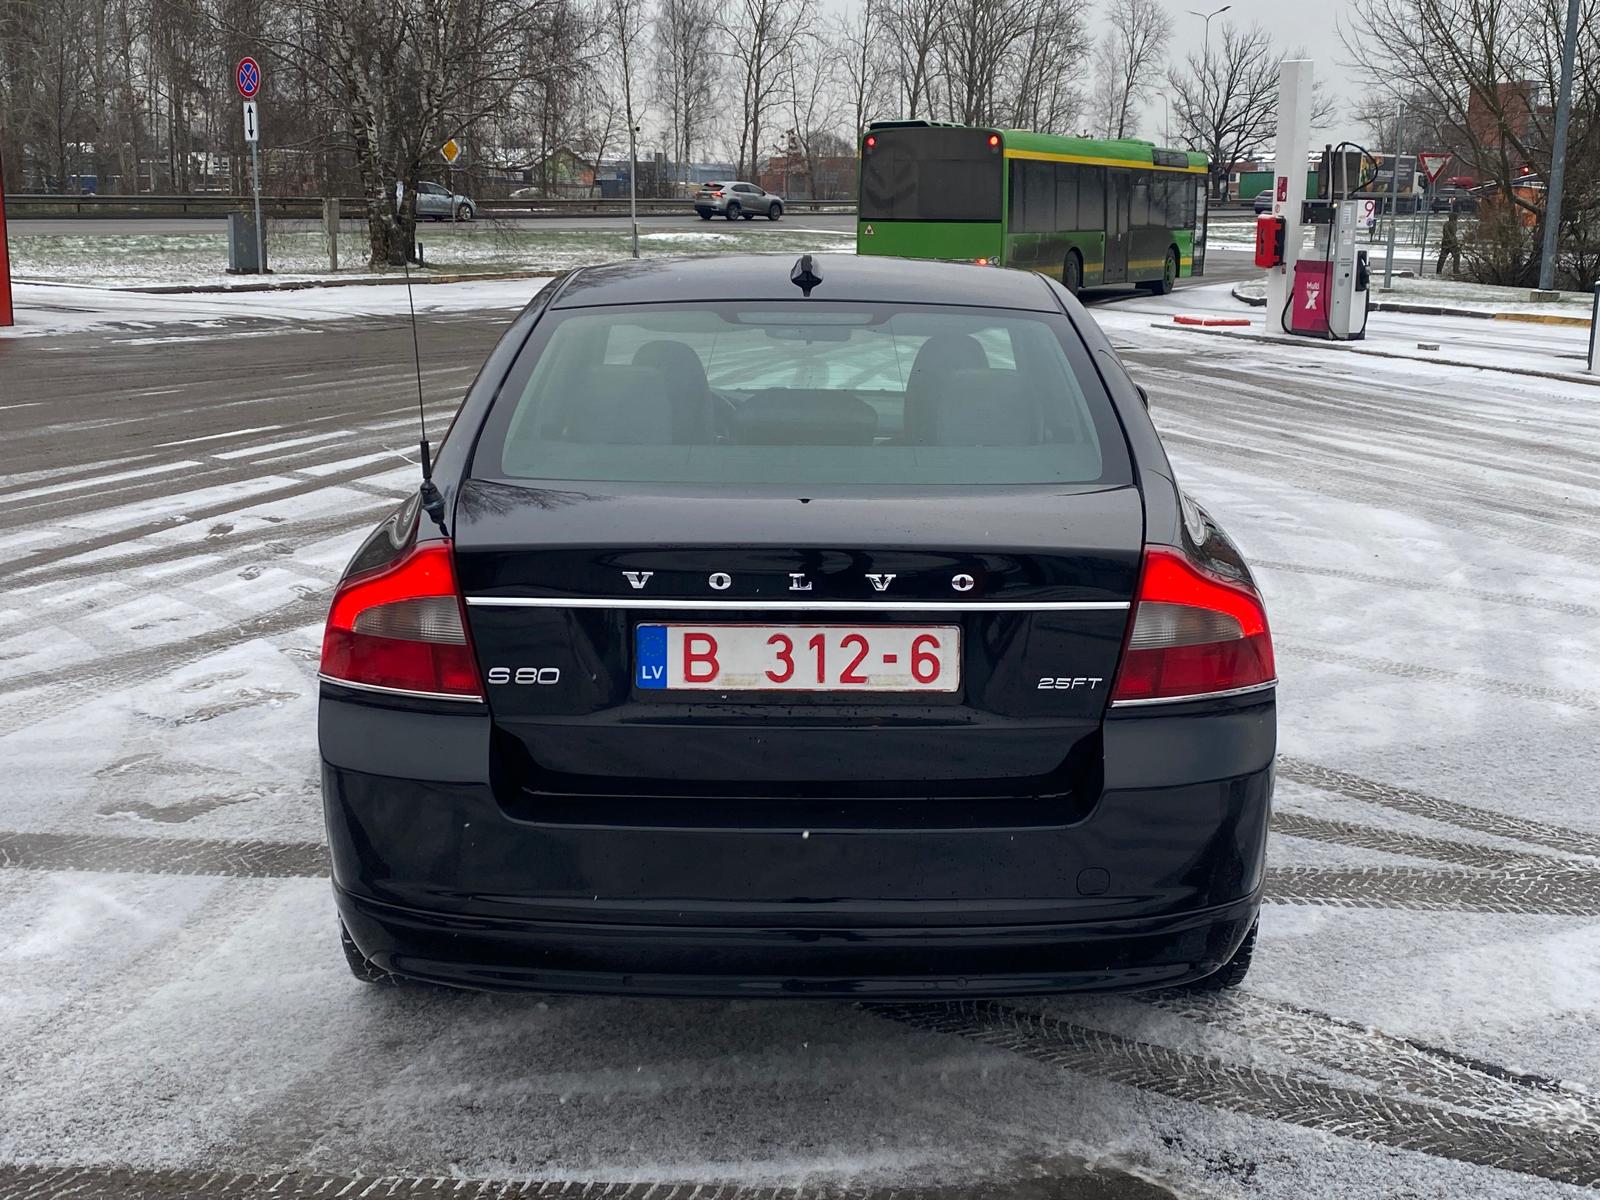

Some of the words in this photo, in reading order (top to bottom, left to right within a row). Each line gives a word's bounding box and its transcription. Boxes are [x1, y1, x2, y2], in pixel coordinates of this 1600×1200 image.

[1364, 200, 1375, 218] 9
[1306, 281, 1320, 289] Multi
[1305, 290, 1320, 310] X
[622, 571, 975, 592] VOLVO
[683, 632, 720, 683] B
[765, 632, 941, 684] 312-6
[642, 665, 663, 680] LV
[1037, 677, 1103, 690] 25FT
